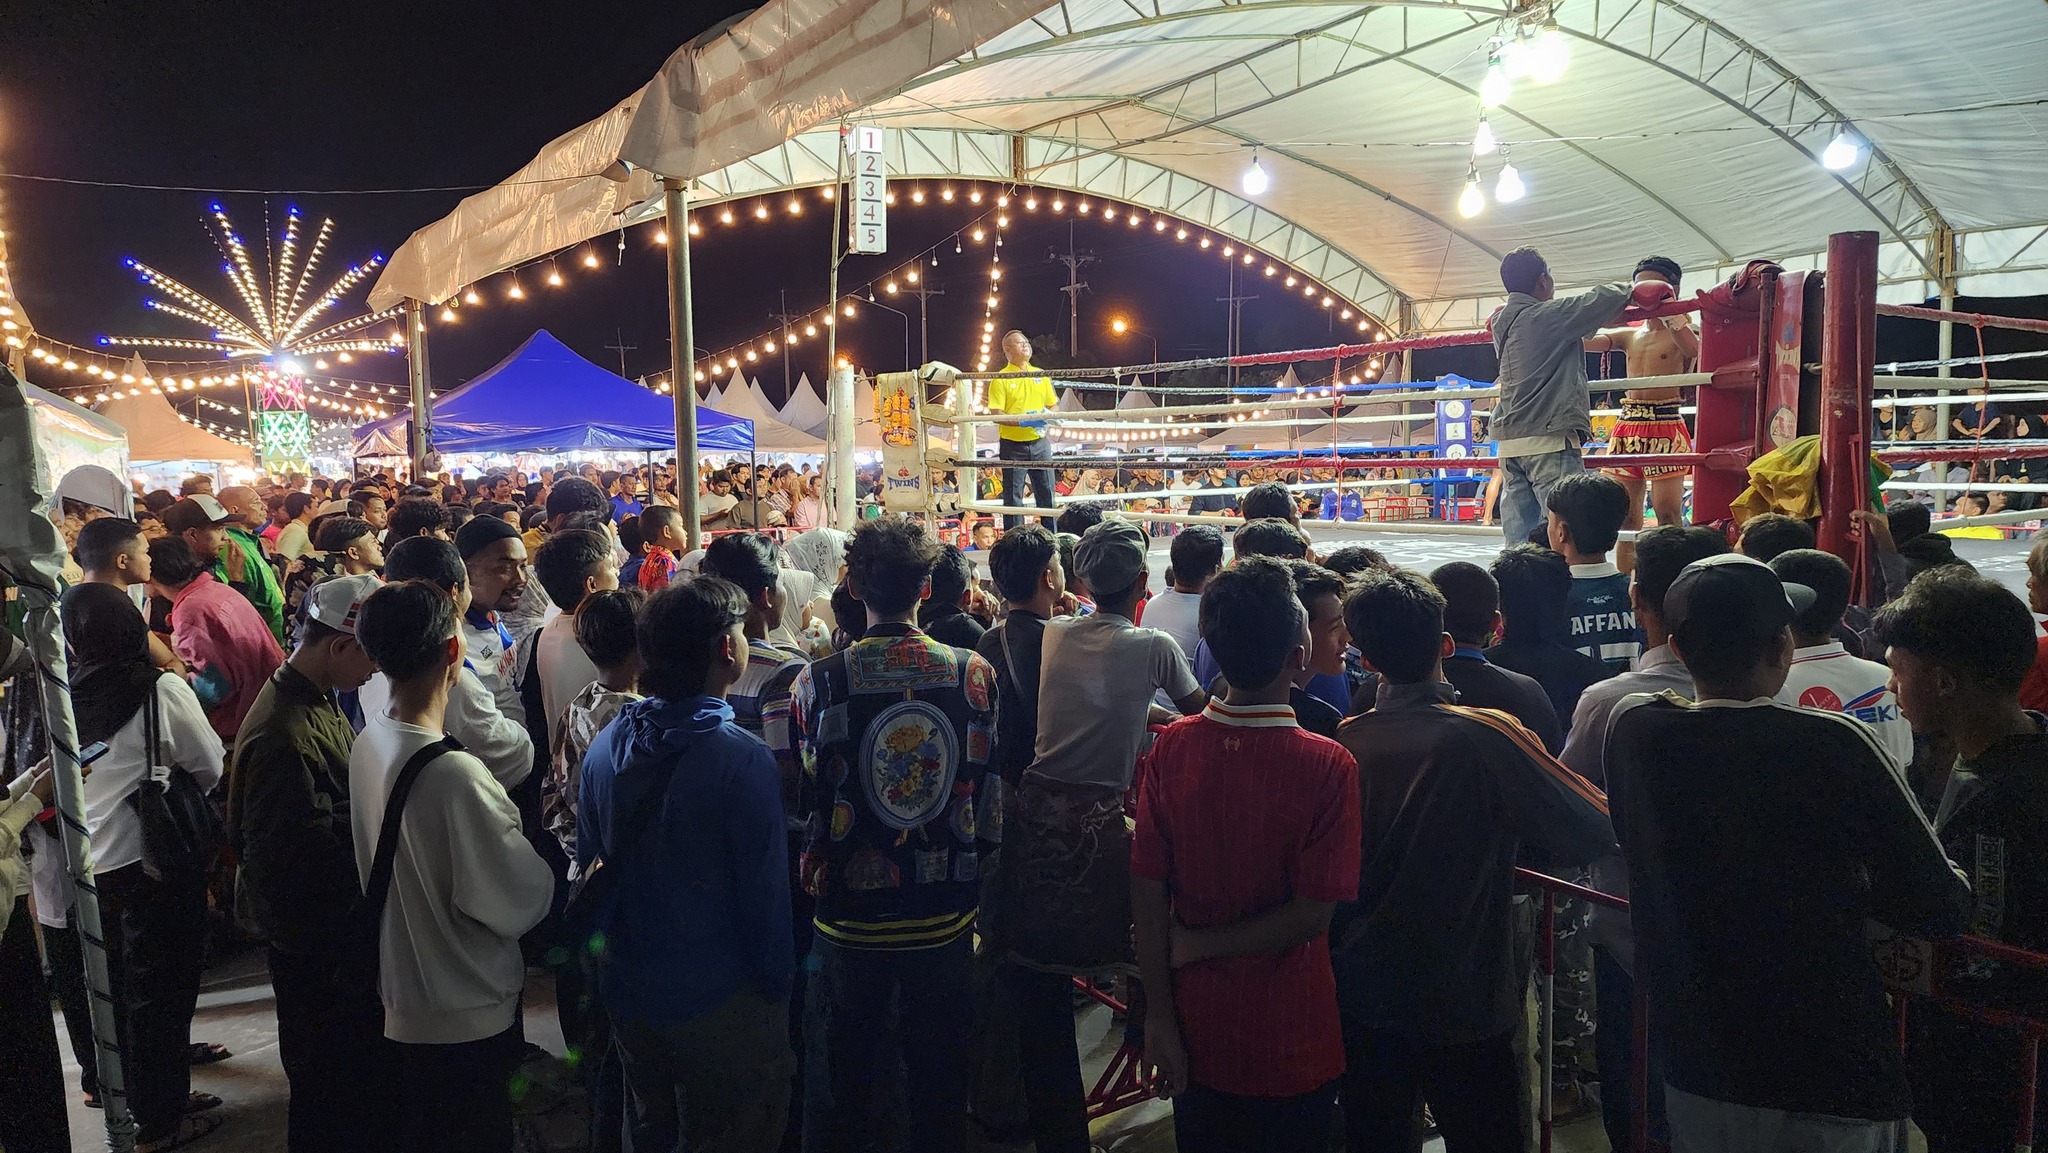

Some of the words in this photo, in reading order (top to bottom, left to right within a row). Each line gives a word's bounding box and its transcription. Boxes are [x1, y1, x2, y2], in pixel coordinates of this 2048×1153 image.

[866, 131, 874, 149] 1
[866, 155, 876, 172] 2
[865, 180, 875, 197] 3
[863, 203, 876, 221] 4
[867, 228, 876, 244] 5
[887, 475, 921, 491] TWINS
[1570, 611, 1637, 636] AFFAN
